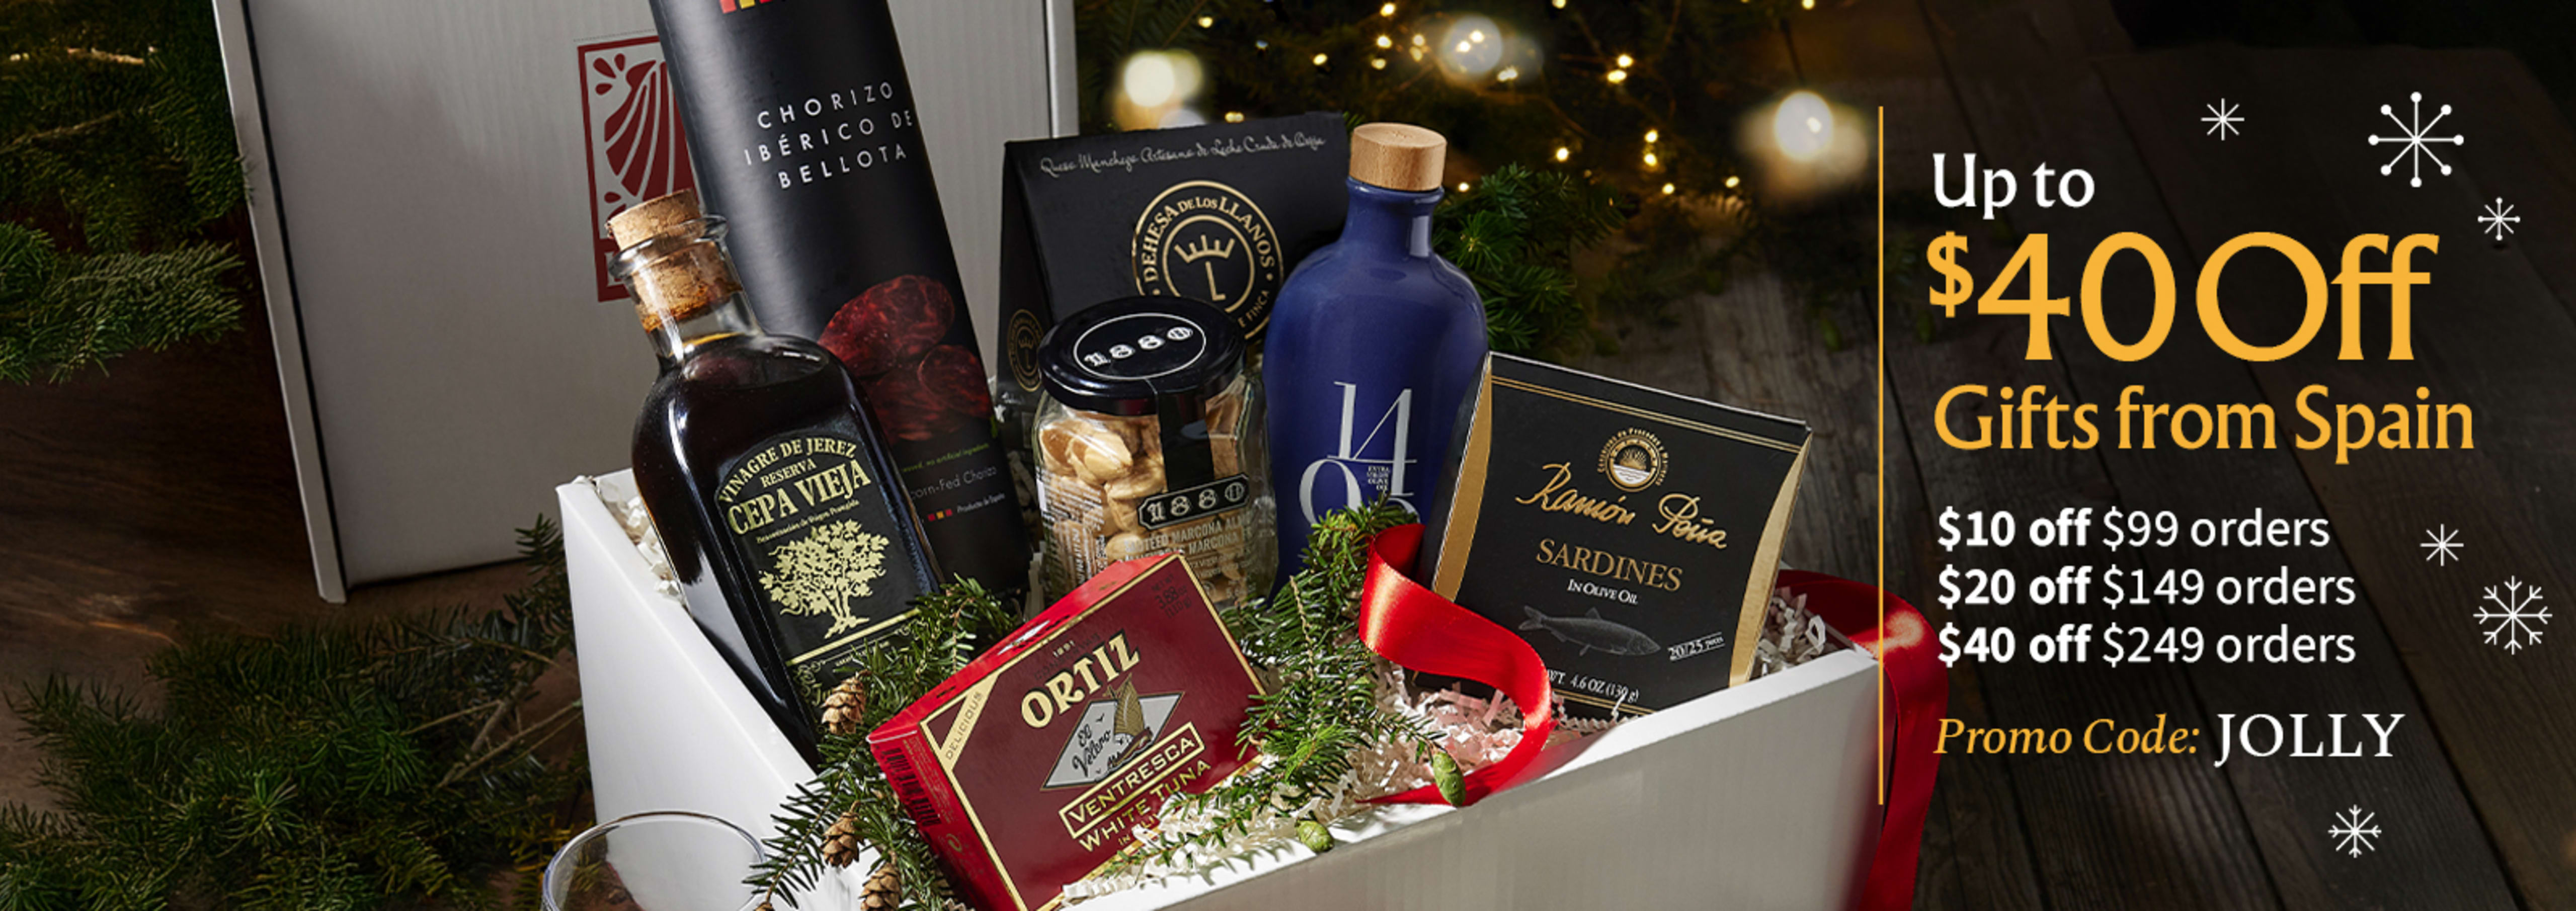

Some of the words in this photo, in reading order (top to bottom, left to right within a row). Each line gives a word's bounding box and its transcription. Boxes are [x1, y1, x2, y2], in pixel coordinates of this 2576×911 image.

[757, 81, 893, 129] CHORIZO
[744, 118, 874, 165] IBÉRICO
[891, 110, 913, 129] DE
[778, 143, 907, 189] BELLOTA
[1141, 204, 1180, 283] DEHESA
[1177, 199, 1196, 213] DE
[1194, 196, 1219, 209] LOS
[1218, 195, 1276, 269] LLANOS
[1245, 290, 1270, 322] FINCA
[1084, 326, 1193, 367] 1880
[1327, 380, 1418, 496] 14
[718, 447, 779, 503] VINAGRE
[779, 439, 803, 458] DE
[806, 437, 857, 459] JEREZ
[760, 458, 818, 488] RESERVA
[910, 474, 961, 500] corn-Fed
[1514, 461, 1637, 526] Ramón
[727, 487, 799, 535] CEPA
[793, 459, 871, 507] VIEJA
[1147, 481, 1245, 523] 1880
[1172, 519, 1223, 544] MARCONA
[1189, 532, 1240, 554] MARCONA
[1536, 538, 1683, 592] SARDINES
[1021, 630, 1141, 728] ORTIZ
[1570, 673, 1586, 689] 4.6
[1587, 679, 1606, 695] OZ
[945, 691, 983, 761] DELICIOUS
[1072, 729, 1111, 778] Velero
[1068, 737, 1195, 823] VENTRESCA
[1079, 798, 1152, 852] WHITE
[1149, 760, 1211, 802] TUNA
